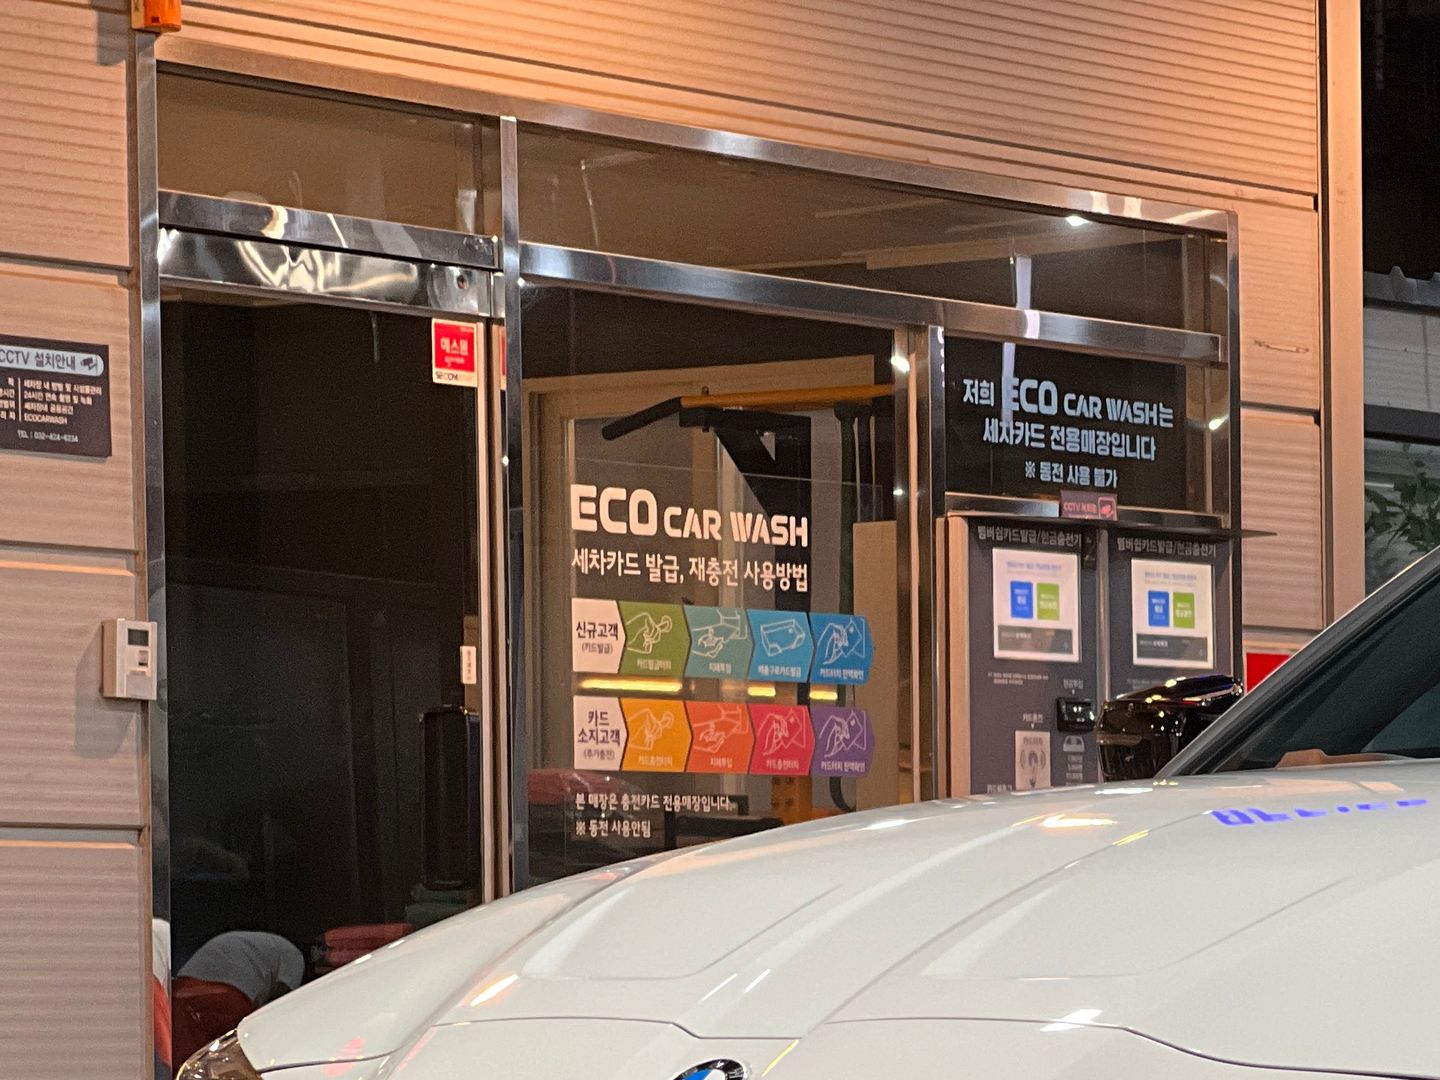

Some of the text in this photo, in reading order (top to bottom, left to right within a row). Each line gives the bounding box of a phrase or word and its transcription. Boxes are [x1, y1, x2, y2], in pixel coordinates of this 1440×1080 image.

[440, 337, 468, 356] 에스원
[35, 351, 76, 370] 설치안내
[963, 376, 1174, 428] 저희 ECO CAR WASH는
[1050, 425, 1157, 461] 전용매장입니다
[1040, 461, 1064, 483] 동전
[1066, 465, 1091, 486] 사용
[1094, 467, 1119, 489] 불가
[570, 483, 809, 548] ECO CAR WASH
[571, 548, 808, 593] 세차카드 발급, 재충전 사용방법
[576, 621, 619, 641] 신규고객
[588, 709, 610, 727] 카드
[577, 728, 621, 748] 소지고객
[575, 793, 585, 810] 본
[588, 793, 619, 811] 매장은
[620, 793, 661, 811] 충전카드
[589, 819, 609, 838] 동전
[612, 819, 651, 839] 사용안됨
